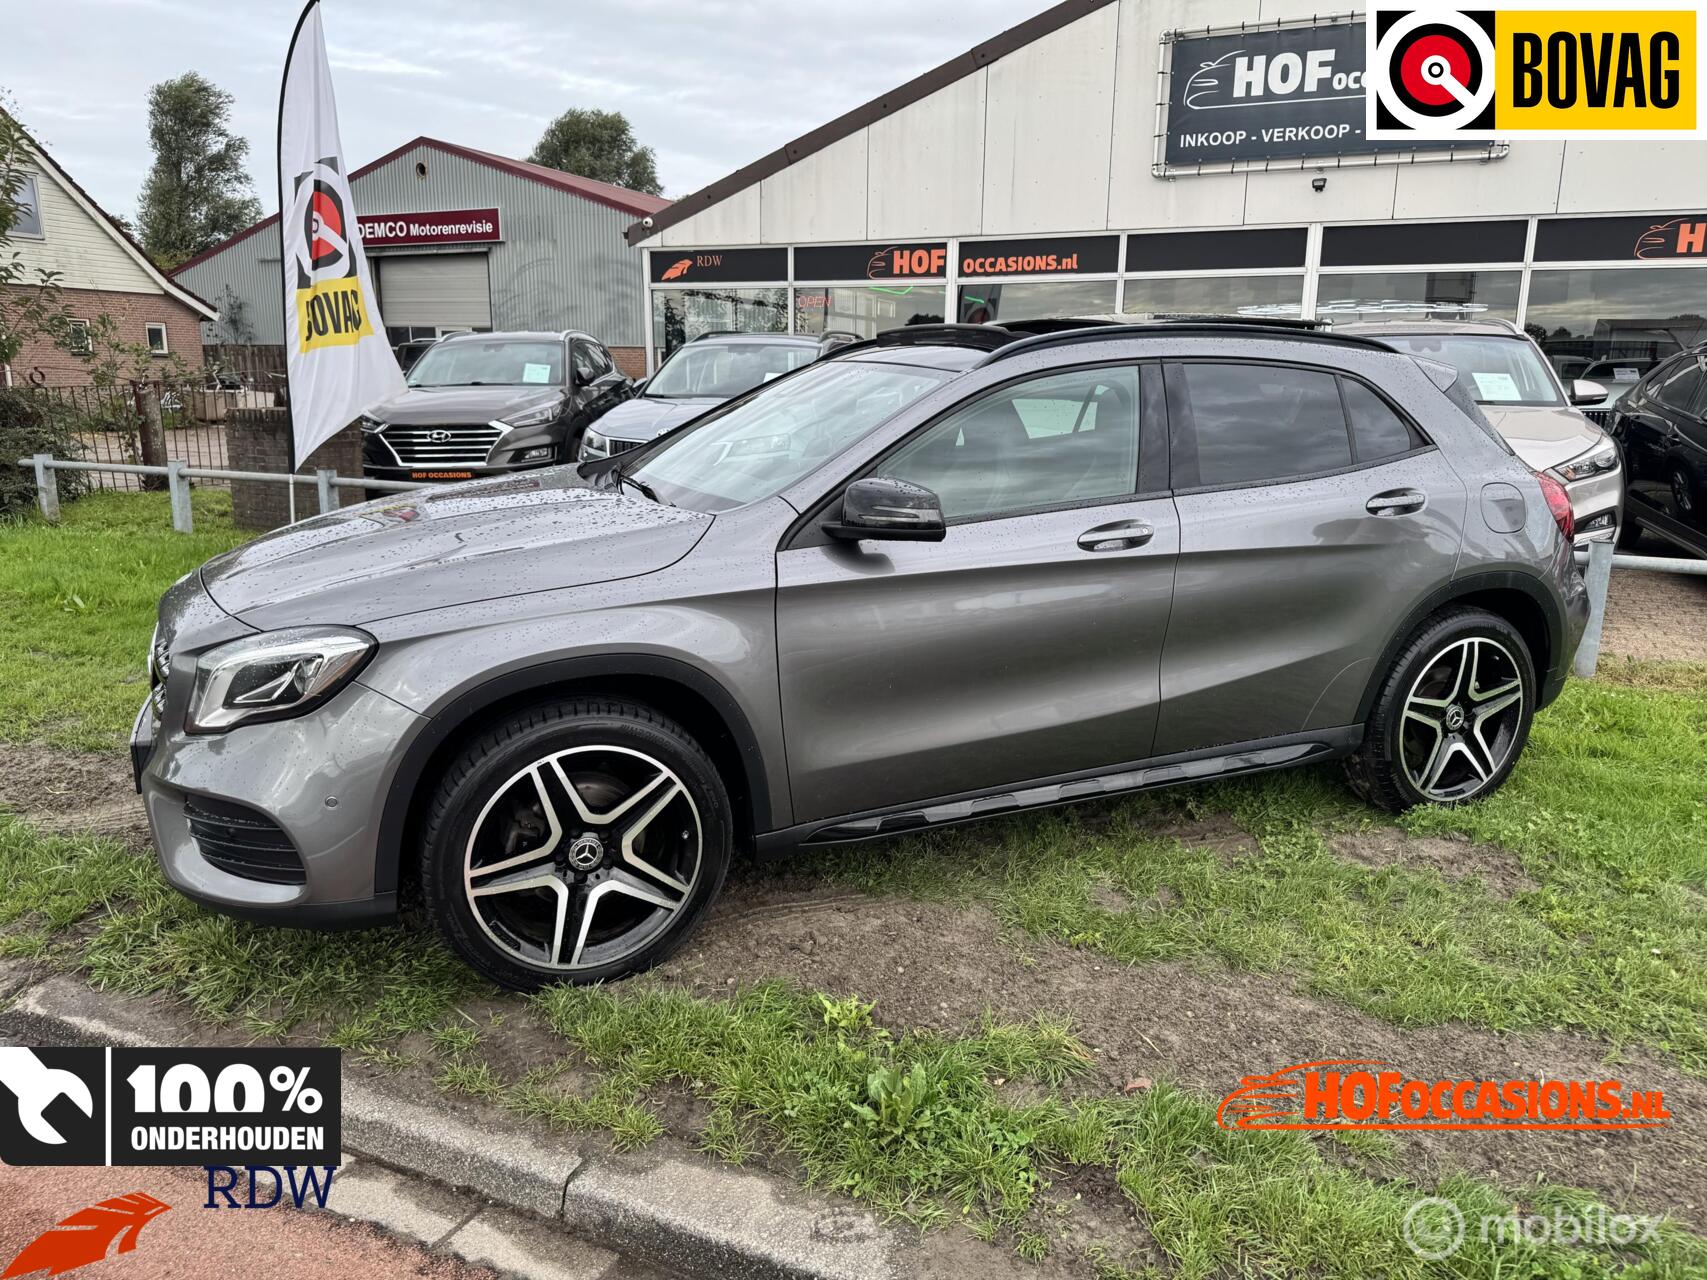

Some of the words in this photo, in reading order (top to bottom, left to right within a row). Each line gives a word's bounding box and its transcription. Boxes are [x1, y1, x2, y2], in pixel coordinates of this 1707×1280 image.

[1179, 130, 1247, 148] INKOOP
[1261, 123, 1351, 143] VERKOOP
[410, 220, 493, 237] Motorenrevisie
[696, 255, 723, 267] RDW
[893, 249, 946, 274] HOF
[963, 253, 1078, 273] OCCASIONS.nl
[797, 296, 832, 308] OPEN
[411, 471, 426, 479] HOF
[428, 471, 472, 479] OCCASIONS
